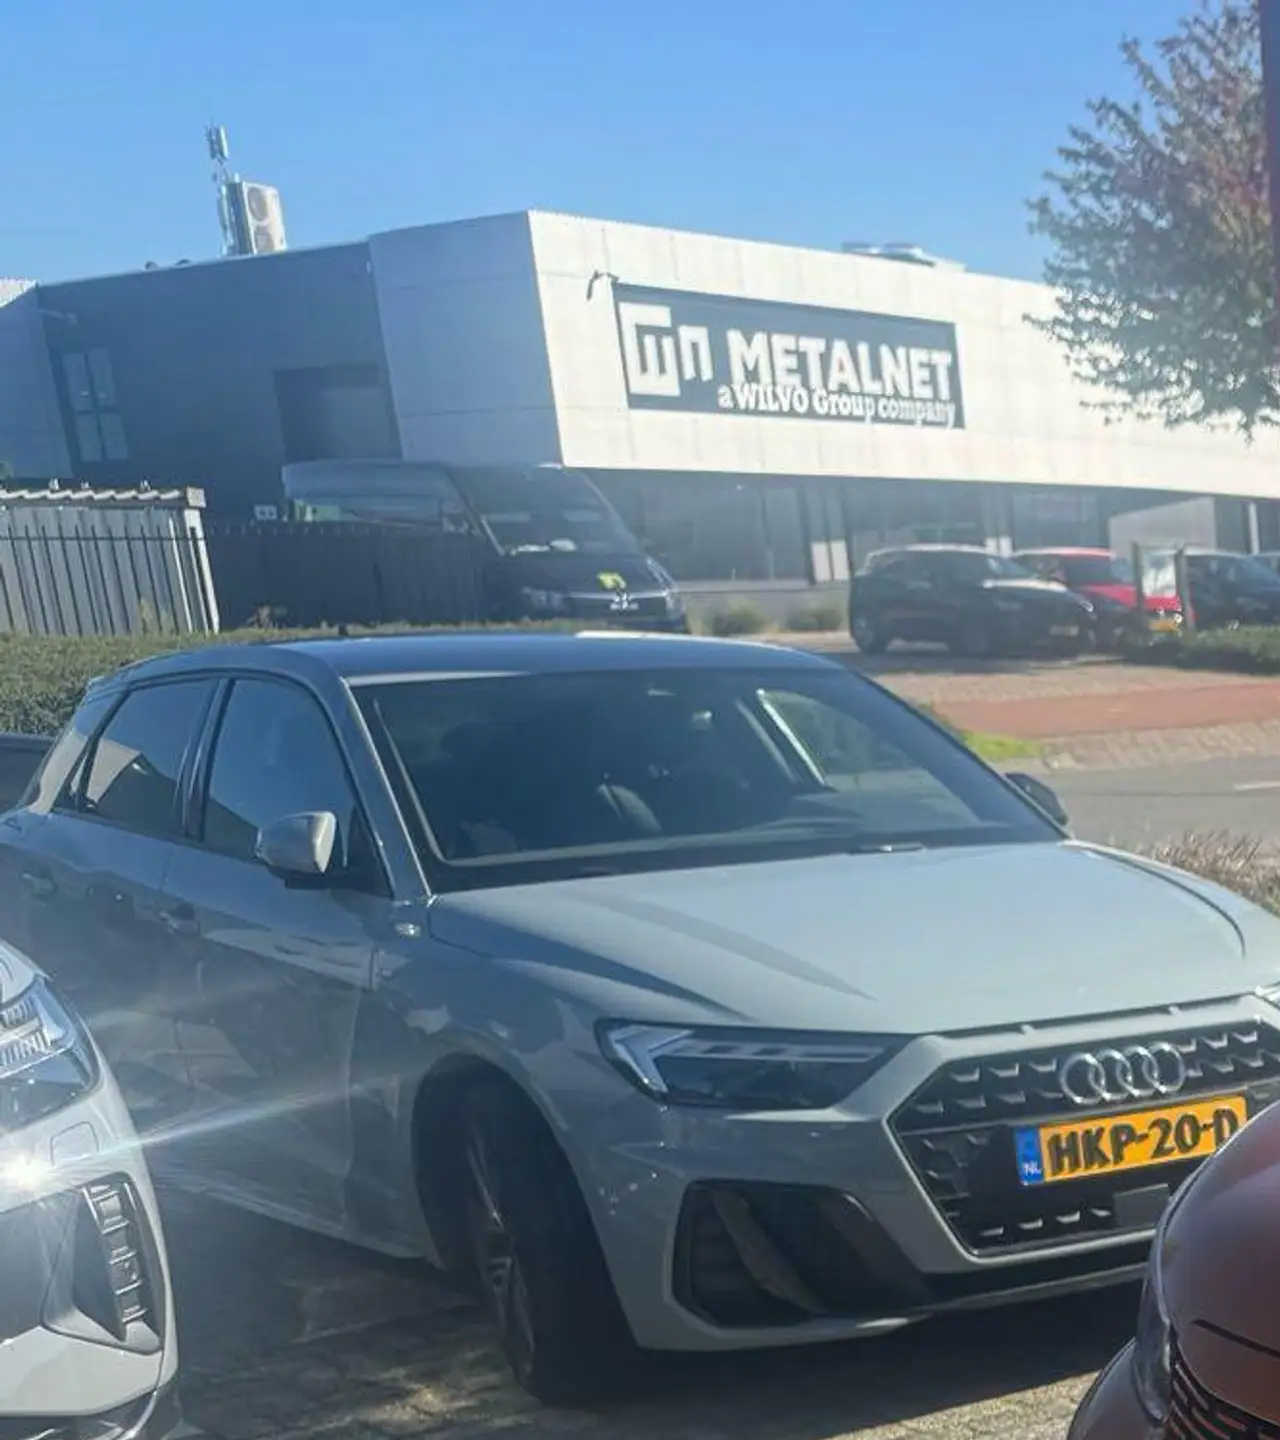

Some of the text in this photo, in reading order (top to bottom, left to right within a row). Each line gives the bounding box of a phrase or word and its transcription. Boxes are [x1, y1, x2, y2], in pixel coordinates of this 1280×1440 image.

[726, 329, 953, 401] METALNET
[717, 382, 956, 430] a WILVO Group company
[1047, 1107, 1239, 1176] HKP-20-D
